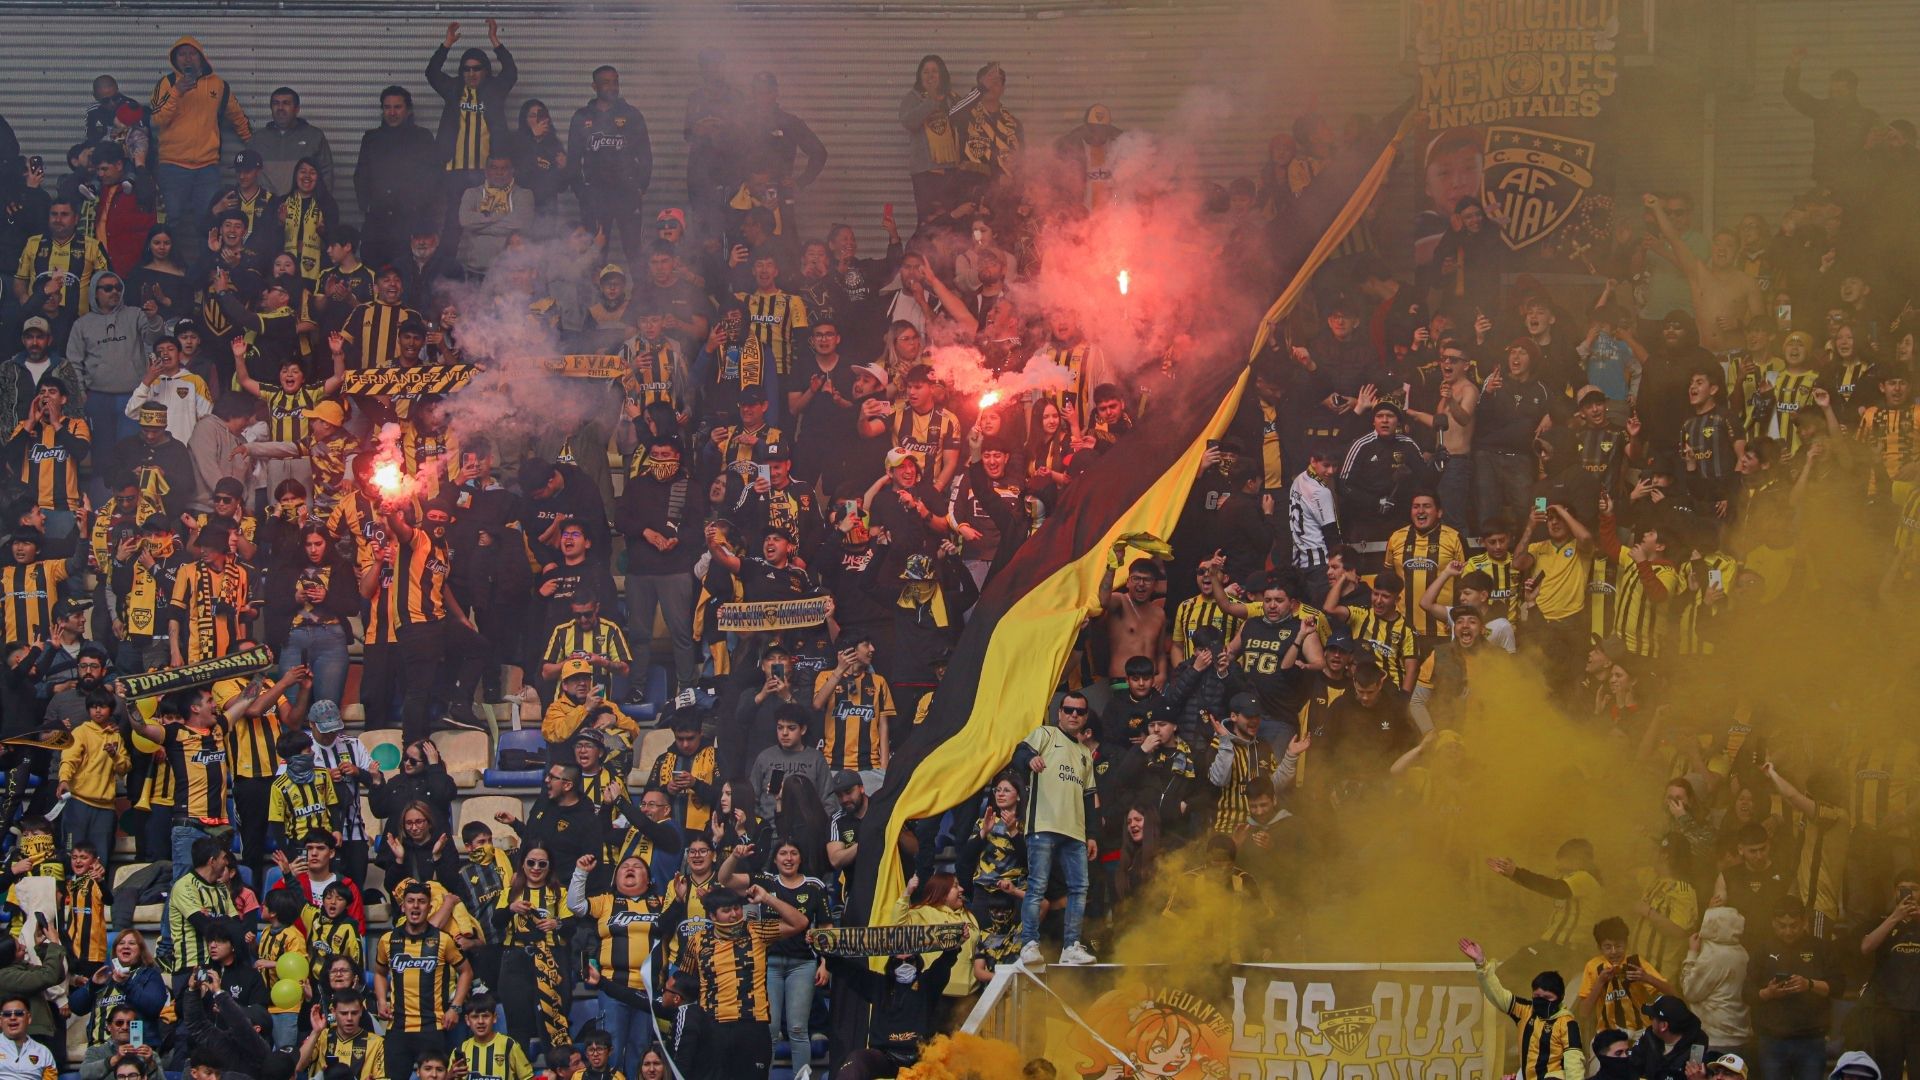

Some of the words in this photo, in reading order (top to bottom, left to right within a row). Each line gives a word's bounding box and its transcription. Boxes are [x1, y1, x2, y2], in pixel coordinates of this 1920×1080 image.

[1428, 91, 1601, 130] INMORTALES
[446, 369, 471, 382] VIA
[397, 385, 434, 393] 1903
[1246, 638, 1281, 652] 1988
[1243, 652, 1279, 675] FG
[126, 671, 180, 695] FURIA
[837, 703, 874, 722] Lucero
[197, 751, 226, 766] Lucer
[613, 911, 659, 927] Lucer
[393, 955, 437, 973] Lucero
[1229, 976, 1336, 1057] LAS
[1366, 980, 1484, 1058] AUR
